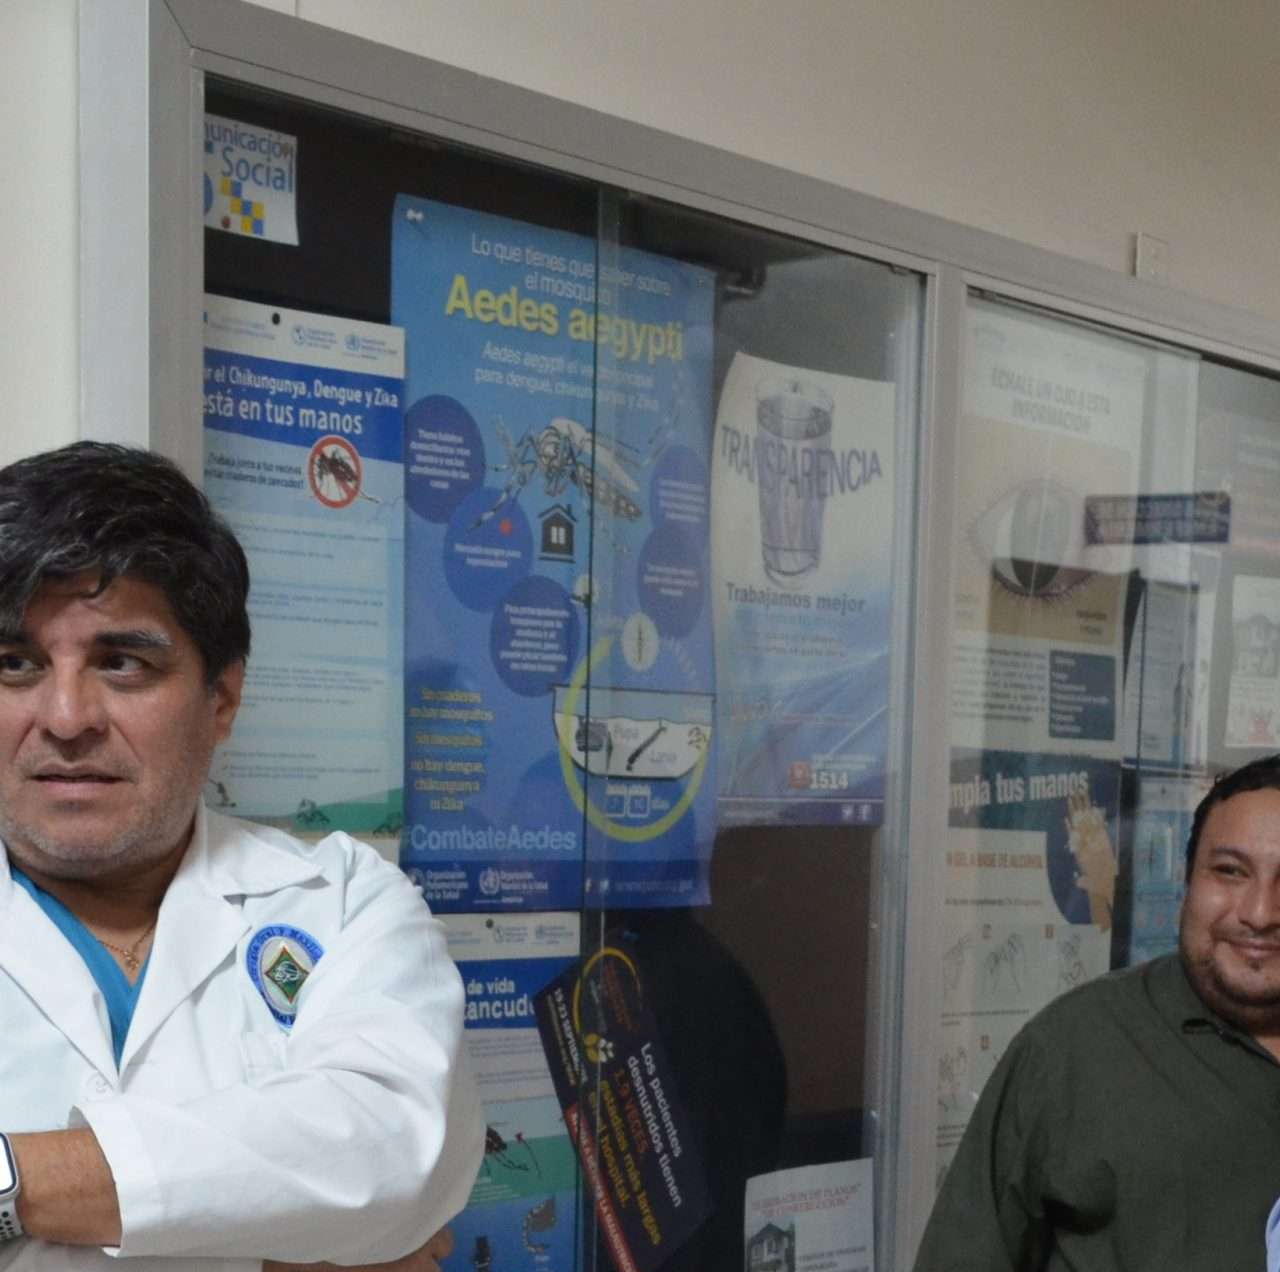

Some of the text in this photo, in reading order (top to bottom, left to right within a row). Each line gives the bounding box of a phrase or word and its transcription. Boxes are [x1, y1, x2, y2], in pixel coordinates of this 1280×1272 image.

[221, 146, 293, 193] Social
[472, 235, 489, 256] Lo
[495, 243, 520, 265] que
[525, 246, 566, 273] tienes
[525, 273, 541, 290] el
[445, 273, 685, 365] Aedes aegypti
[214, 365, 225, 383] el
[229, 365, 312, 399] Chikungunya,
[314, 378, 362, 406] Dengue
[366, 392, 372, 408] y
[373, 386, 399, 408] Zika
[474, 367, 505, 385] para
[239, 398, 261, 421] en
[264, 400, 295, 426] tus
[298, 406, 363, 435] manos
[721, 424, 882, 501] TRANSPARENCIA
[726, 582, 865, 616] Trabajamos mejor
[810, 771, 848, 790] 1514
[996, 771, 1025, 803] tus
[1029, 769, 1089, 801] manos
[467, 976, 516, 995] de vida
[640, 1042, 682, 1158] Los pacientes
[627, 1055, 683, 1208] desnutridos tienen
